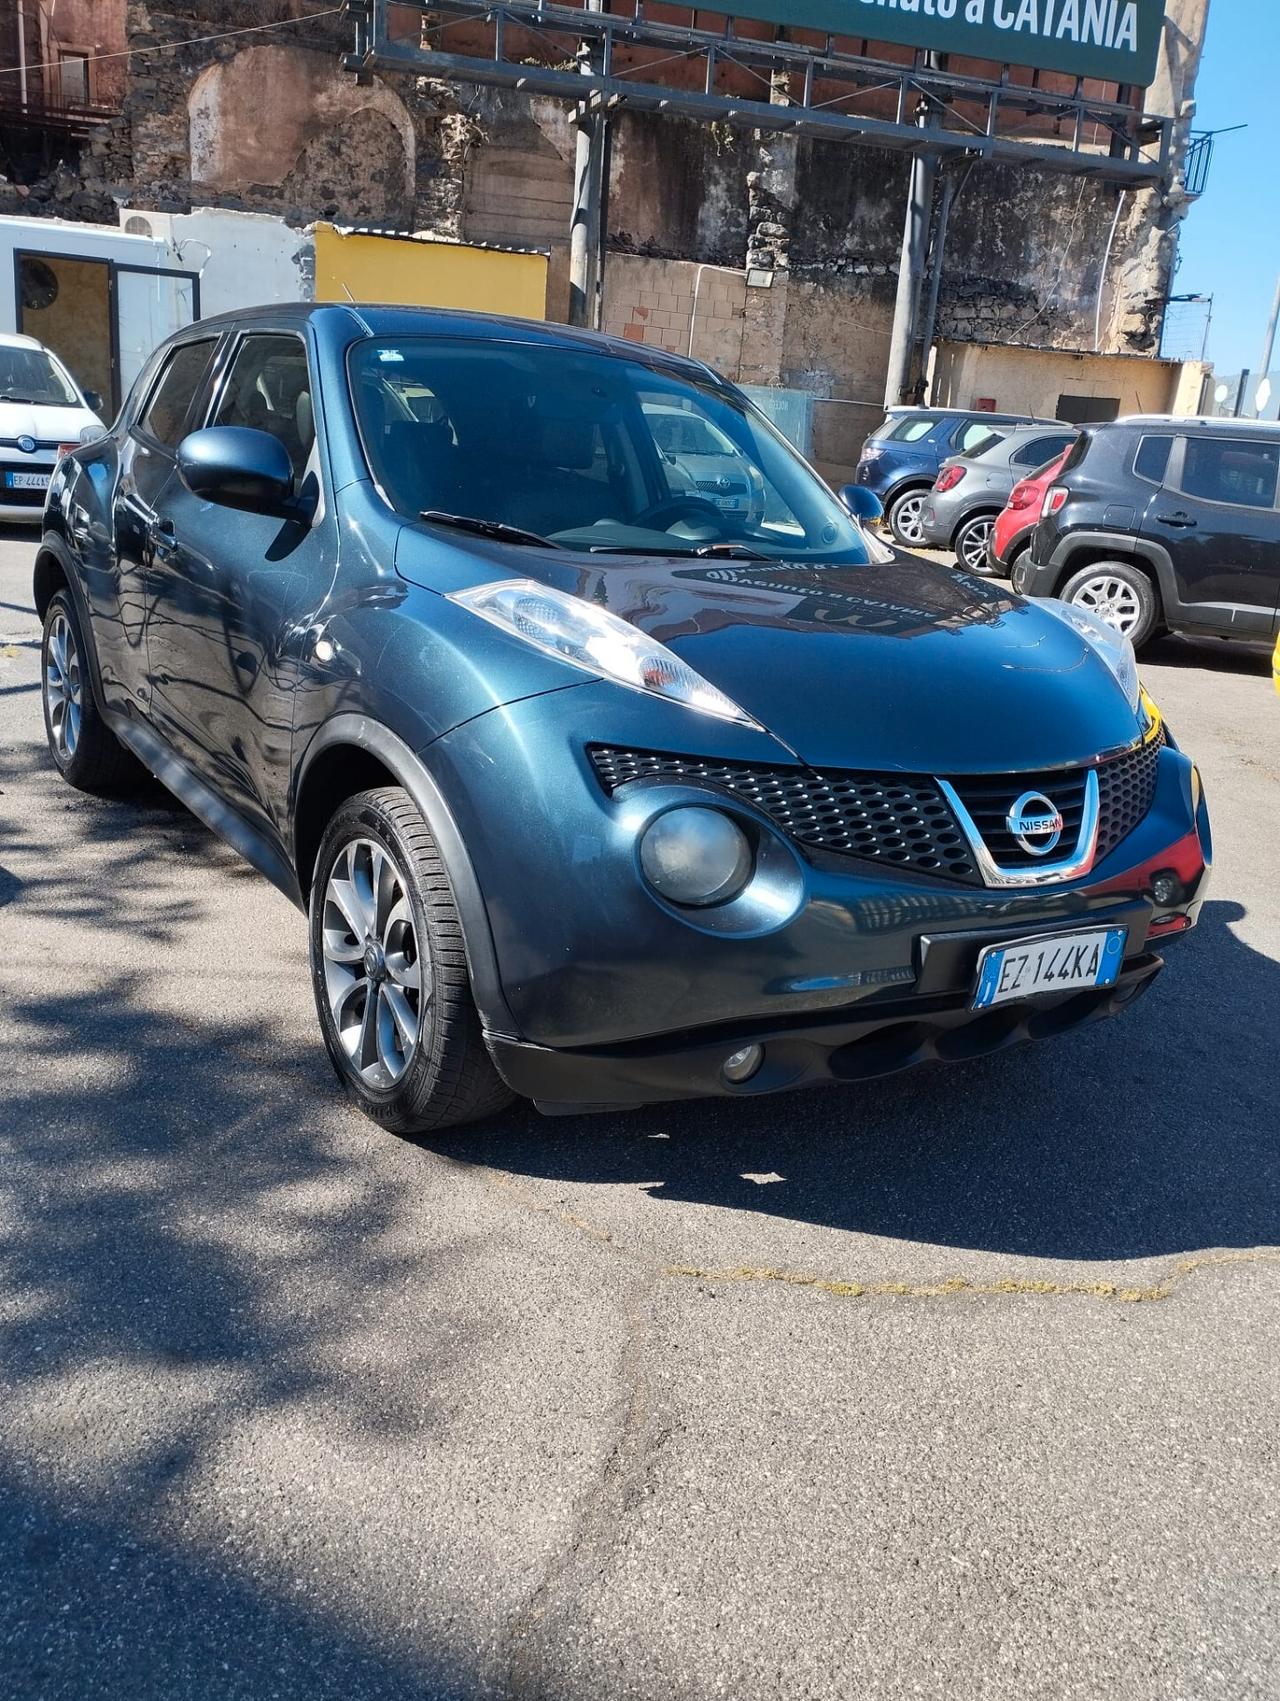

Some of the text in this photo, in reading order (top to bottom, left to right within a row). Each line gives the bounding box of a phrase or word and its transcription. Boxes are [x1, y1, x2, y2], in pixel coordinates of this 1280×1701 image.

[965, 0, 985, 24] a
[993, 0, 1137, 52] CATANIA
[1018, 817, 1062, 831] NISSAN
[998, 954, 1029, 993] EZ
[1033, 944, 1099, 984] 144KA
